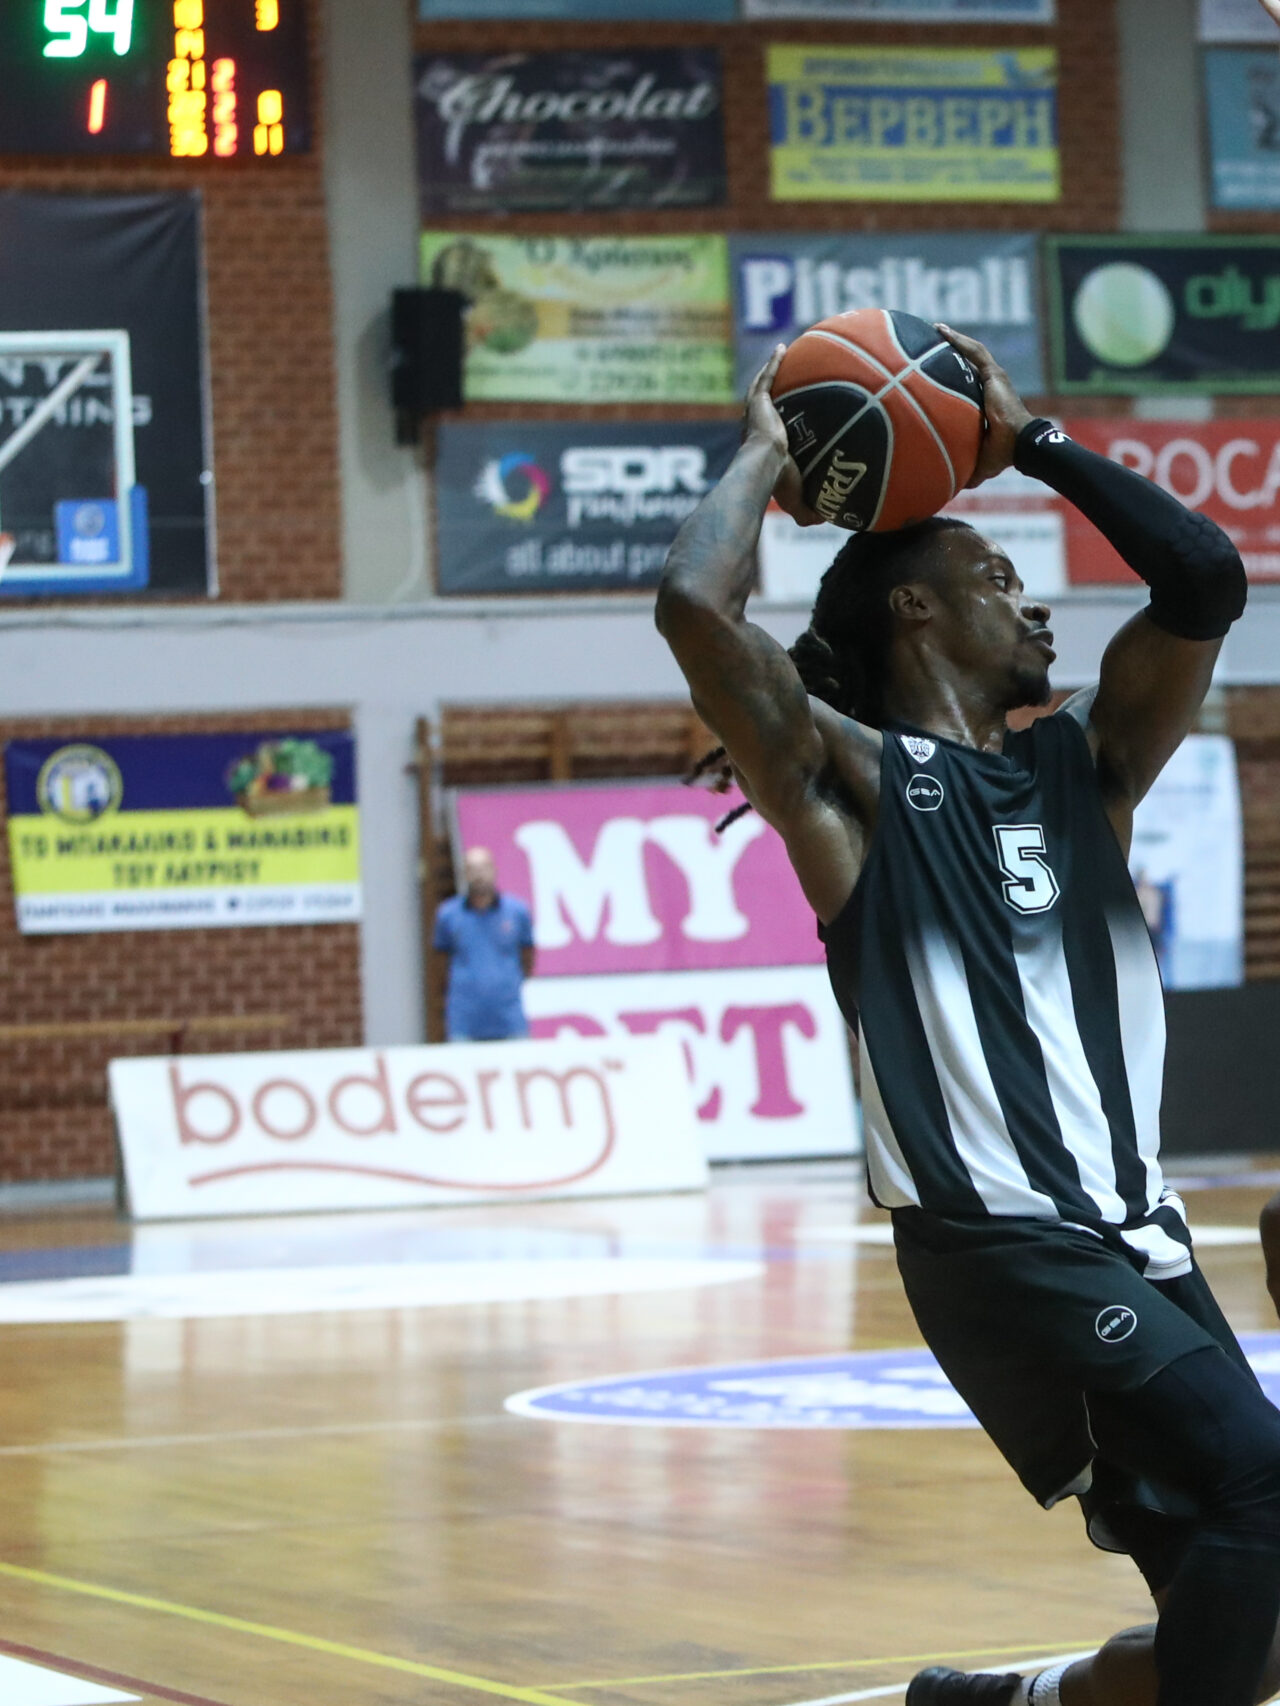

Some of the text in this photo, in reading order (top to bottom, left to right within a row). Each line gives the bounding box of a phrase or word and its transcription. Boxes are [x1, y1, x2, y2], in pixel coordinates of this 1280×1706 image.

[43, 0, 134, 57] 54
[88, 79, 107, 134] 1
[438, 72, 718, 150] Chocolat
[742, 255, 1031, 328] Pitsikali
[514, 815, 766, 949] MY
[992, 823, 1061, 915] 5
[168, 1055, 616, 1172] boderm
